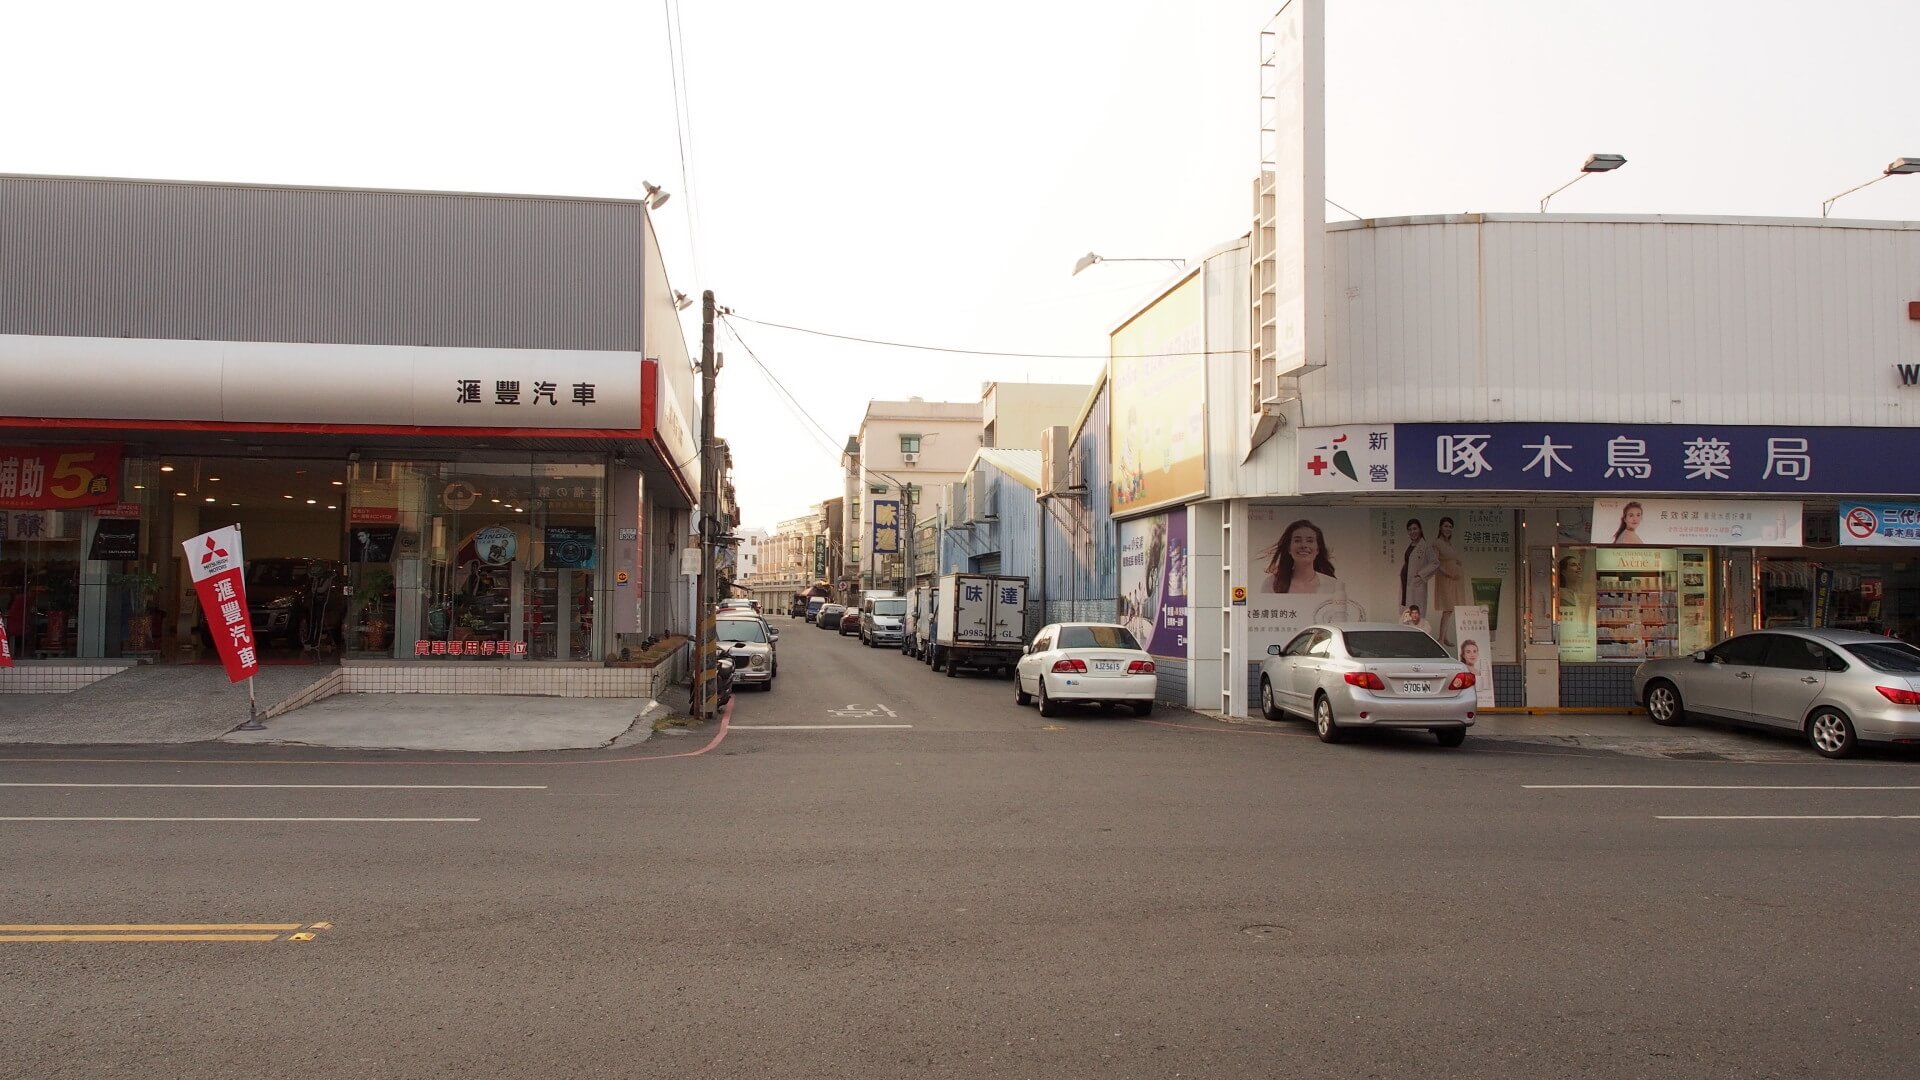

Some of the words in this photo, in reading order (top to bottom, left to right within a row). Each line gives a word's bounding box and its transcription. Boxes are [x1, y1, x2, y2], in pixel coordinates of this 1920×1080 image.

[1368, 432, 1389, 483] 新營
[1436, 433, 1811, 481] 啄木鳥藥局
[963, 629, 984, 637] 0985
